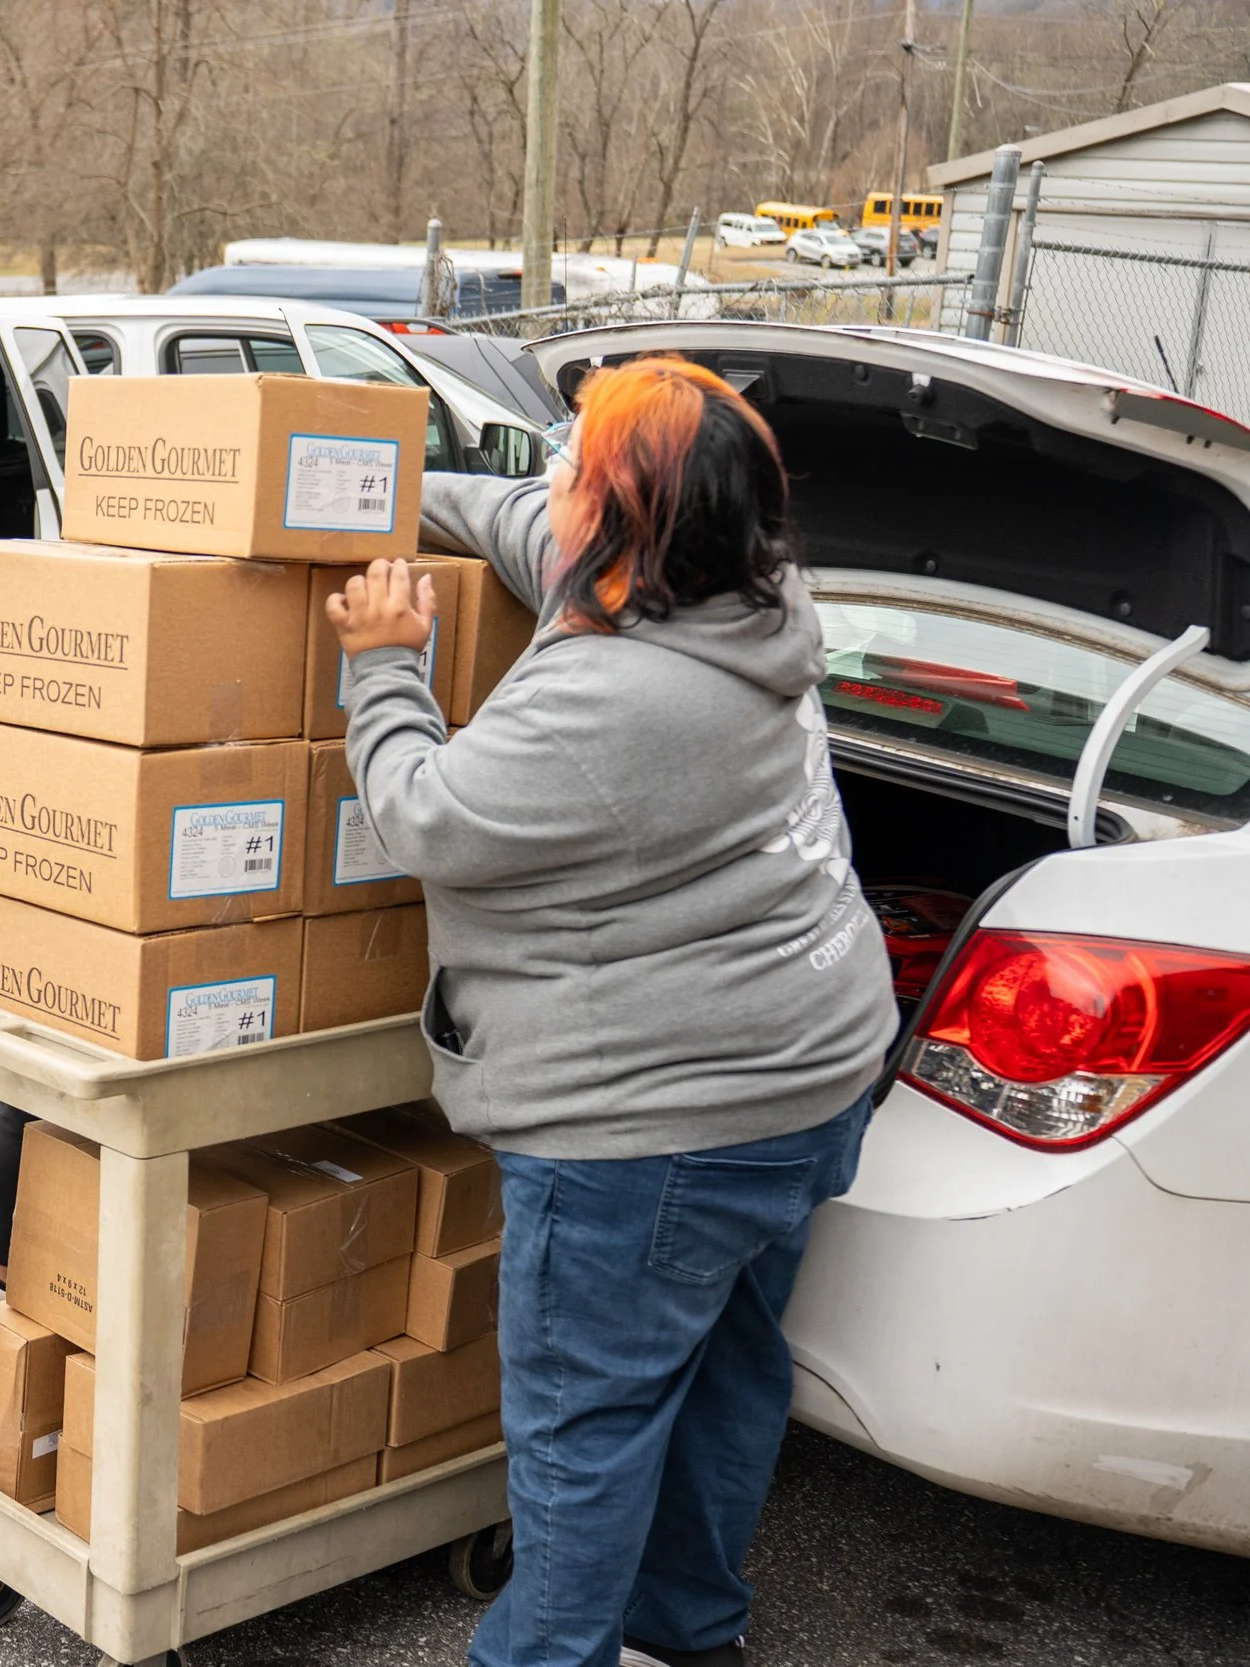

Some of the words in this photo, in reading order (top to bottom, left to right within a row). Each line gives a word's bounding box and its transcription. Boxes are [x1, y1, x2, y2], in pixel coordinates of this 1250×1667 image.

[80, 436, 148, 473] GOLDEN
[151, 437, 241, 477] GOURMET
[307, 442, 340, 459] GOLDEN
[340, 445, 382, 461] GOURMET
[298, 456, 318, 468] 4324
[359, 475, 387, 493] #1
[95, 495, 138, 519] KEEP
[143, 498, 215, 525] FROZEN
[28, 615, 129, 664] GOURMET
[20, 675, 102, 710] FROZEN
[20, 794, 117, 852] GOURMET
[190, 812, 224, 827] GOLDEN
[225, 809, 267, 825] GOURMET
[182, 826, 203, 838] 4324
[246, 836, 273, 854] #1
[14, 850, 92, 894] FROZEN
[26, 967, 121, 1033] GOURMET
[186, 992, 218, 1008] GOLDEN
[219, 988, 260, 1003] GOURMET
[177, 1006, 198, 1018] 4324
[238, 1010, 265, 1030] #1
[57, 1273, 61, 1282] 4
[67, 1279, 72, 1288] 9
[50, 1282, 93, 1312] ASTM-D-5118
[78, 1285, 86, 1296] 12
